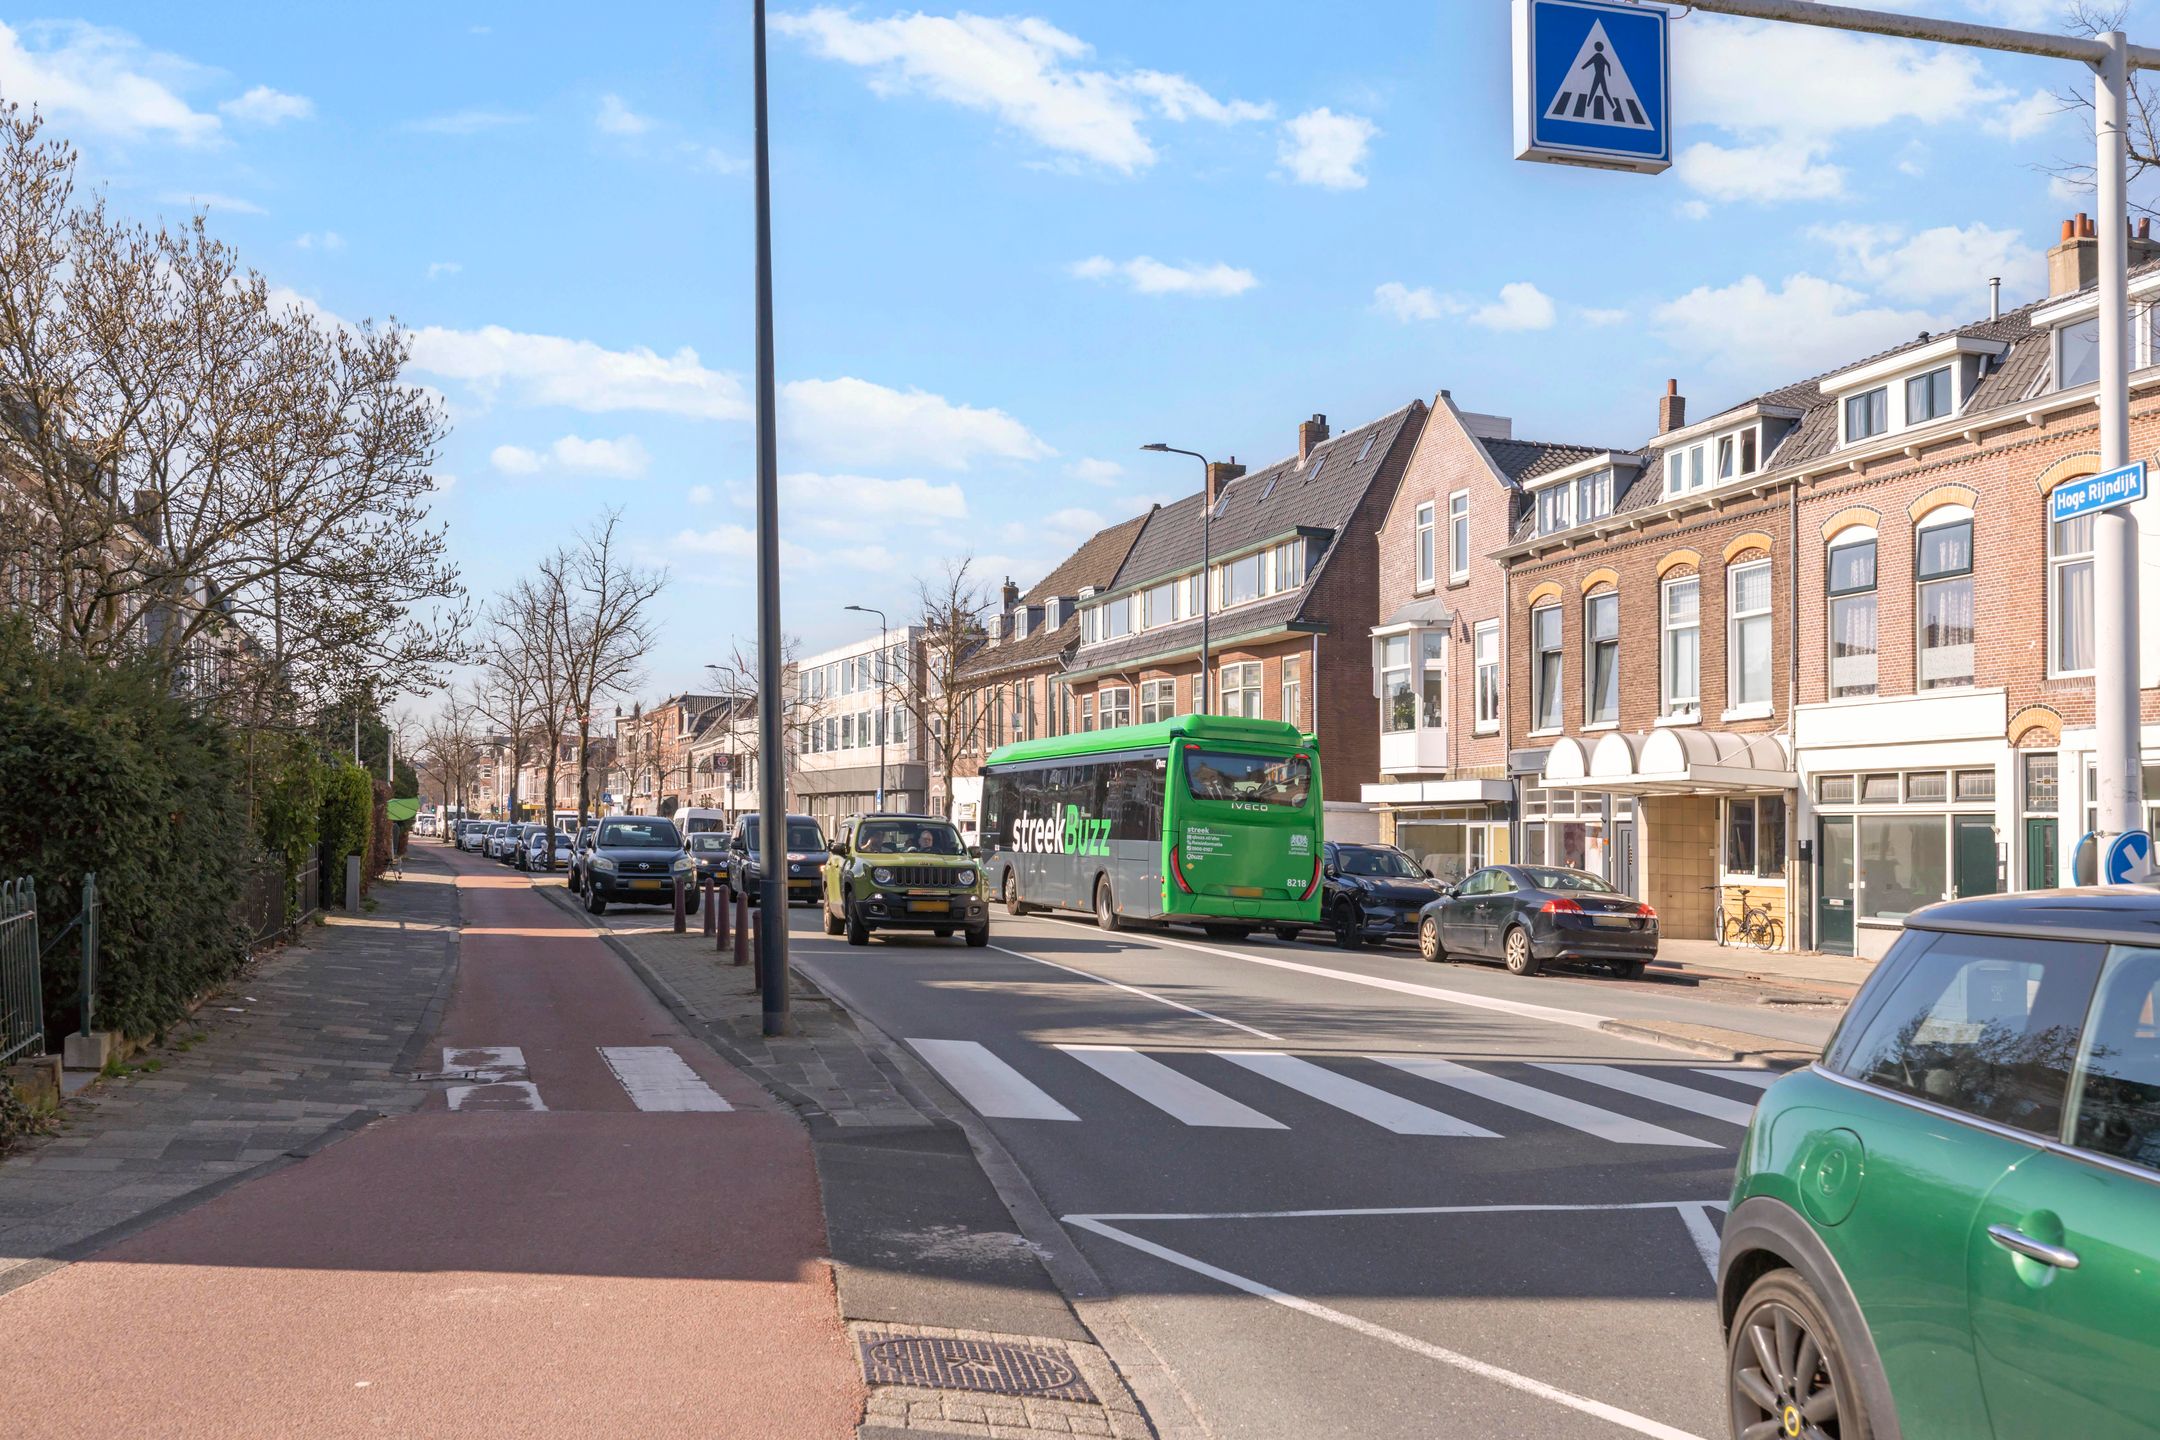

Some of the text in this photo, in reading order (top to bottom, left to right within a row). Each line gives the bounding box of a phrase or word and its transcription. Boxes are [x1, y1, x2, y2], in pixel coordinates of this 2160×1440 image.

[2057, 472, 2137, 510] Hoge Rijndijk
[1231, 802, 1268, 811] IVECO
[1287, 879, 1307, 888] 8218
